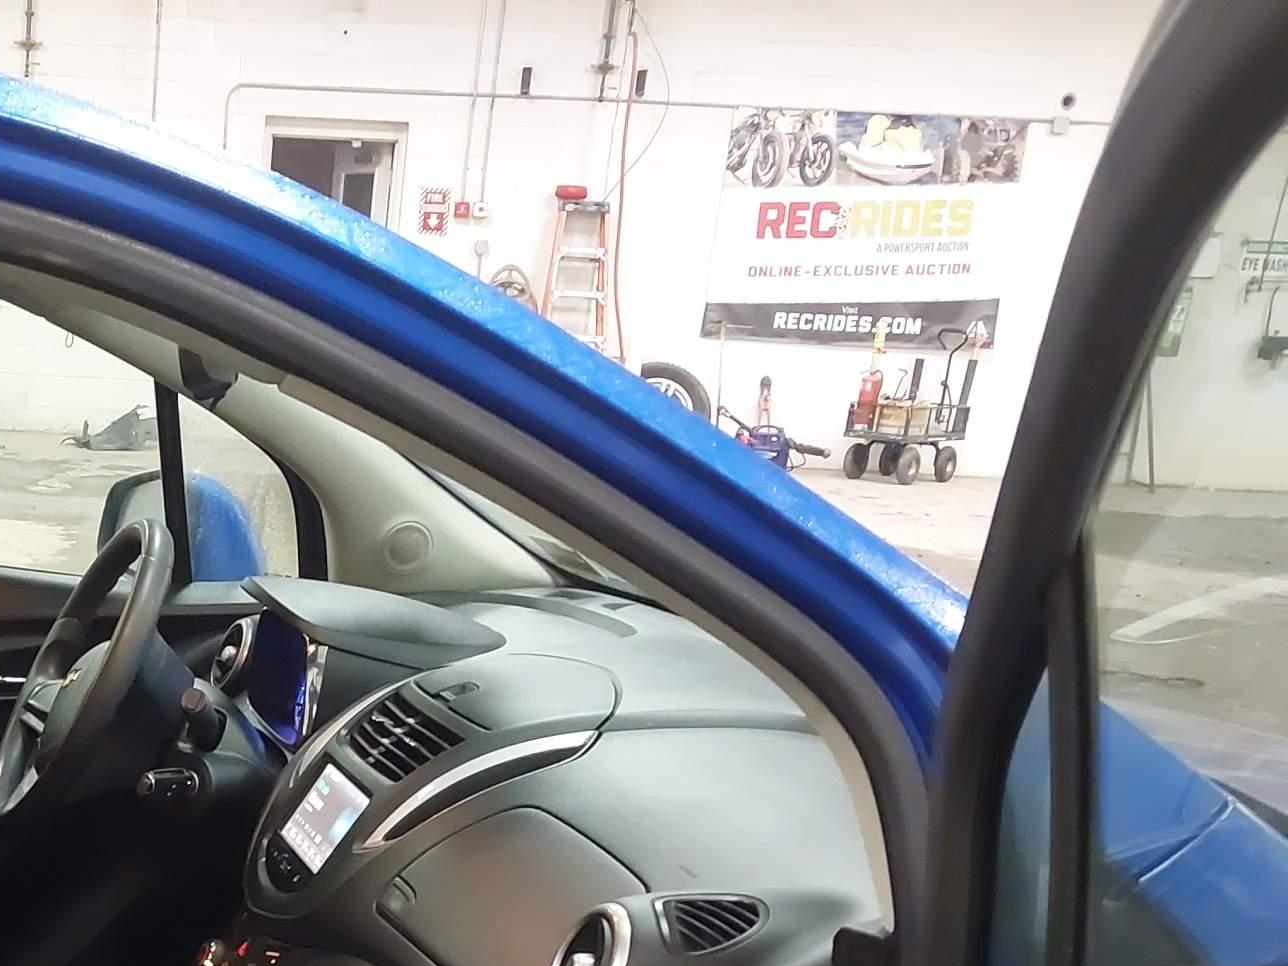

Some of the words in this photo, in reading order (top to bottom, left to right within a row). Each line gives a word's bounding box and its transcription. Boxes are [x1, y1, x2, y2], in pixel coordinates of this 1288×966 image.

[756, 202, 841, 239] REC
[849, 200, 975, 239] RIDES
[937, 241, 969, 252] AUCTION
[748, 265, 900, 278] ONLINE-EXCLUSIVE
[905, 263, 972, 276] AUCTION
[1241, 257, 1259, 271] EYE
[773, 311, 922, 335] RECRIDES.COM
